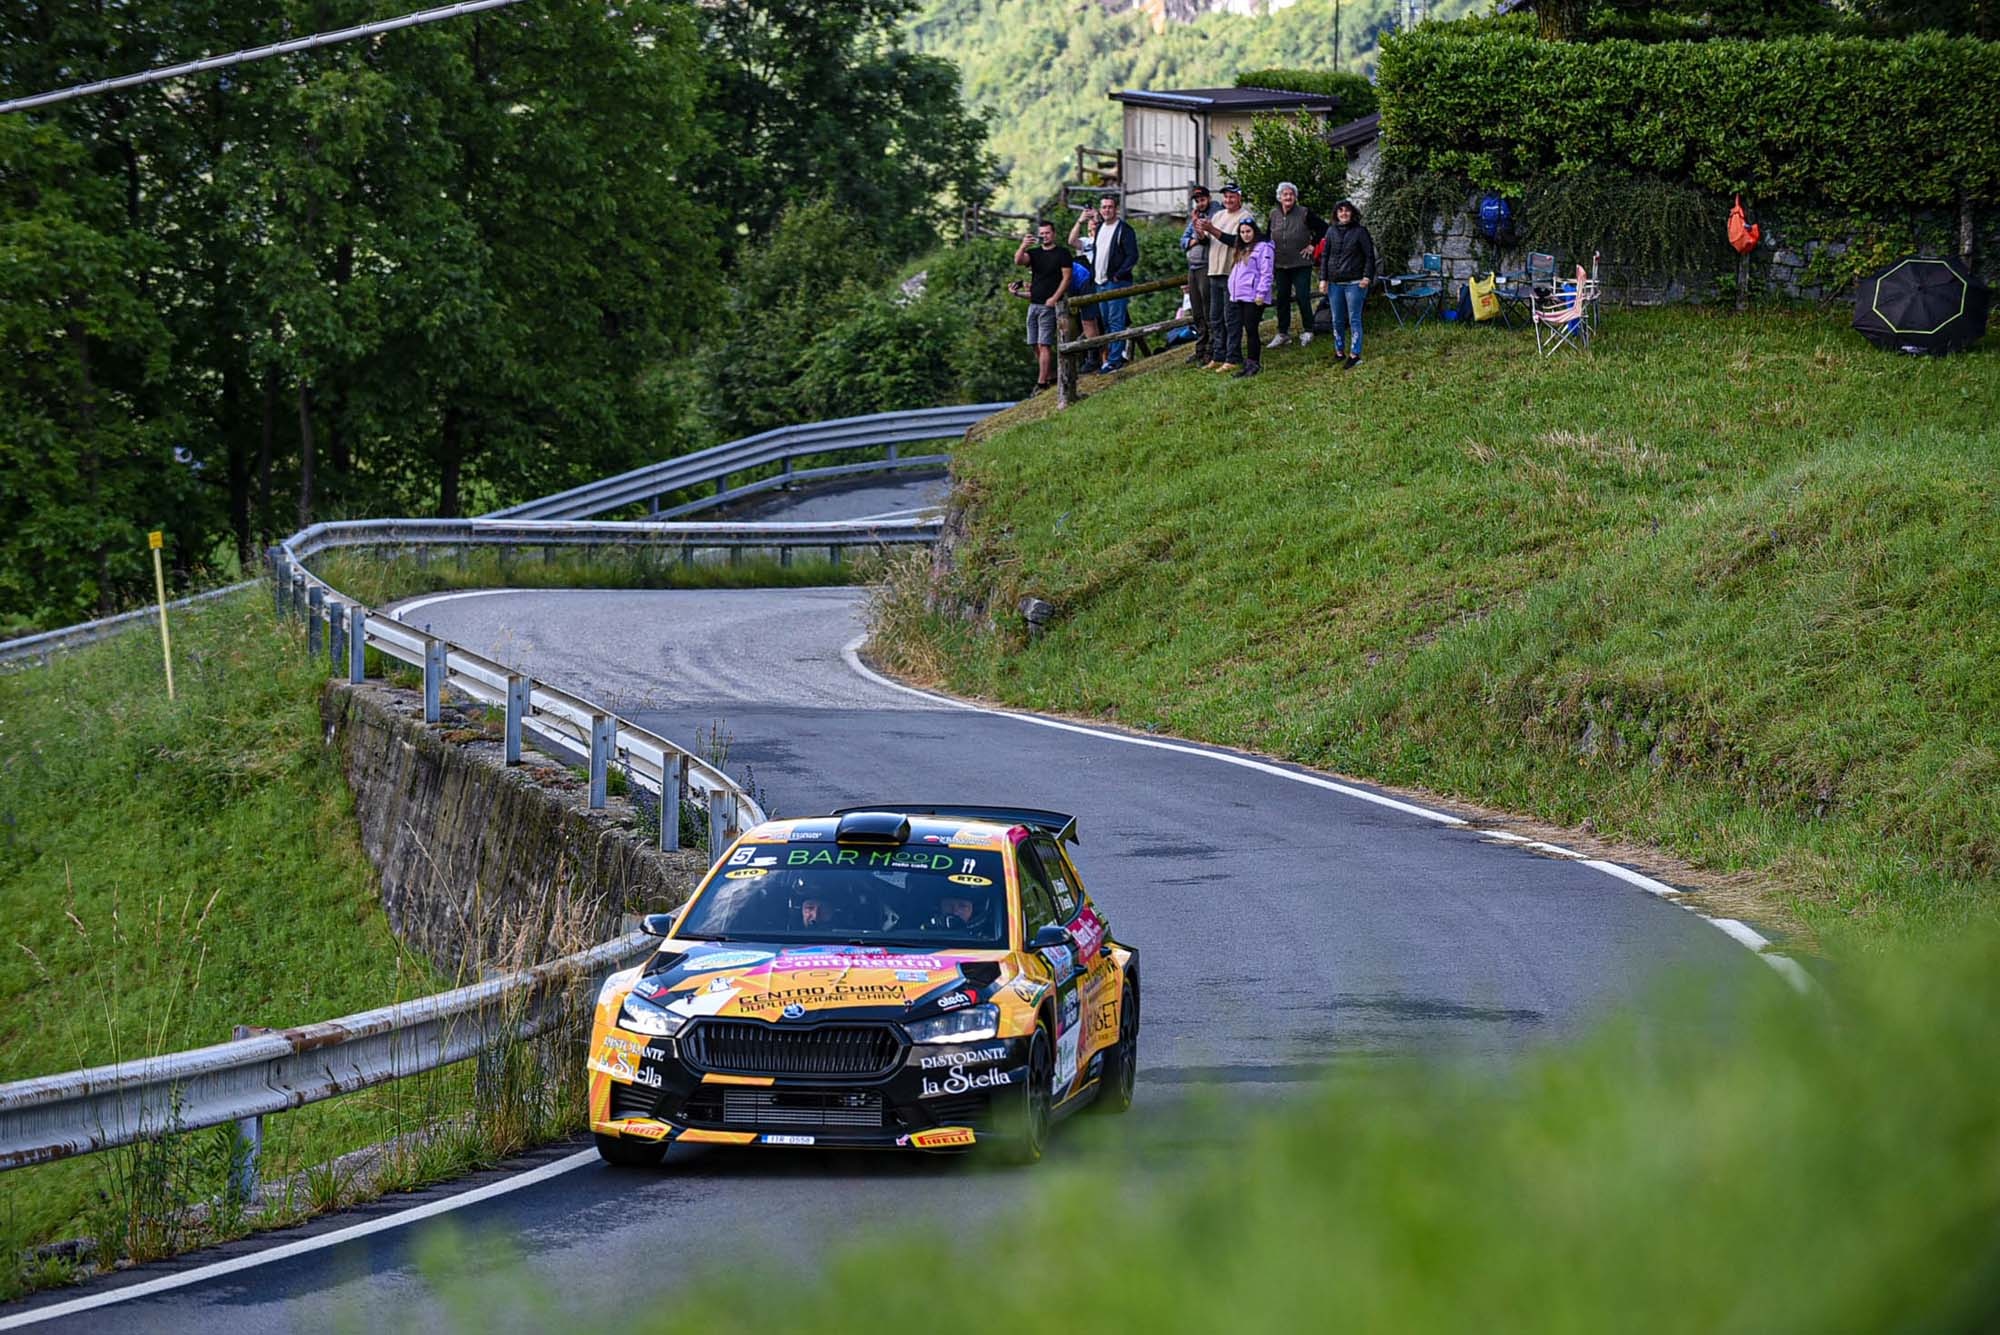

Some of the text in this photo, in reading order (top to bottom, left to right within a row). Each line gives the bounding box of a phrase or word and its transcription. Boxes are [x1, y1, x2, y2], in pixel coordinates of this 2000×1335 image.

[787, 849, 860, 865] BAR
[772, 958, 943, 970] Continental
[738, 985, 904, 1005] CENTRO CHIAVI
[856, 992, 906, 1001] CHIAVI
[920, 1047, 1007, 1070] RISTORANTE
[612, 1051, 663, 1088] Stella
[922, 1063, 1012, 1095] la Stella
[917, 1129, 971, 1146] PIRELLI
